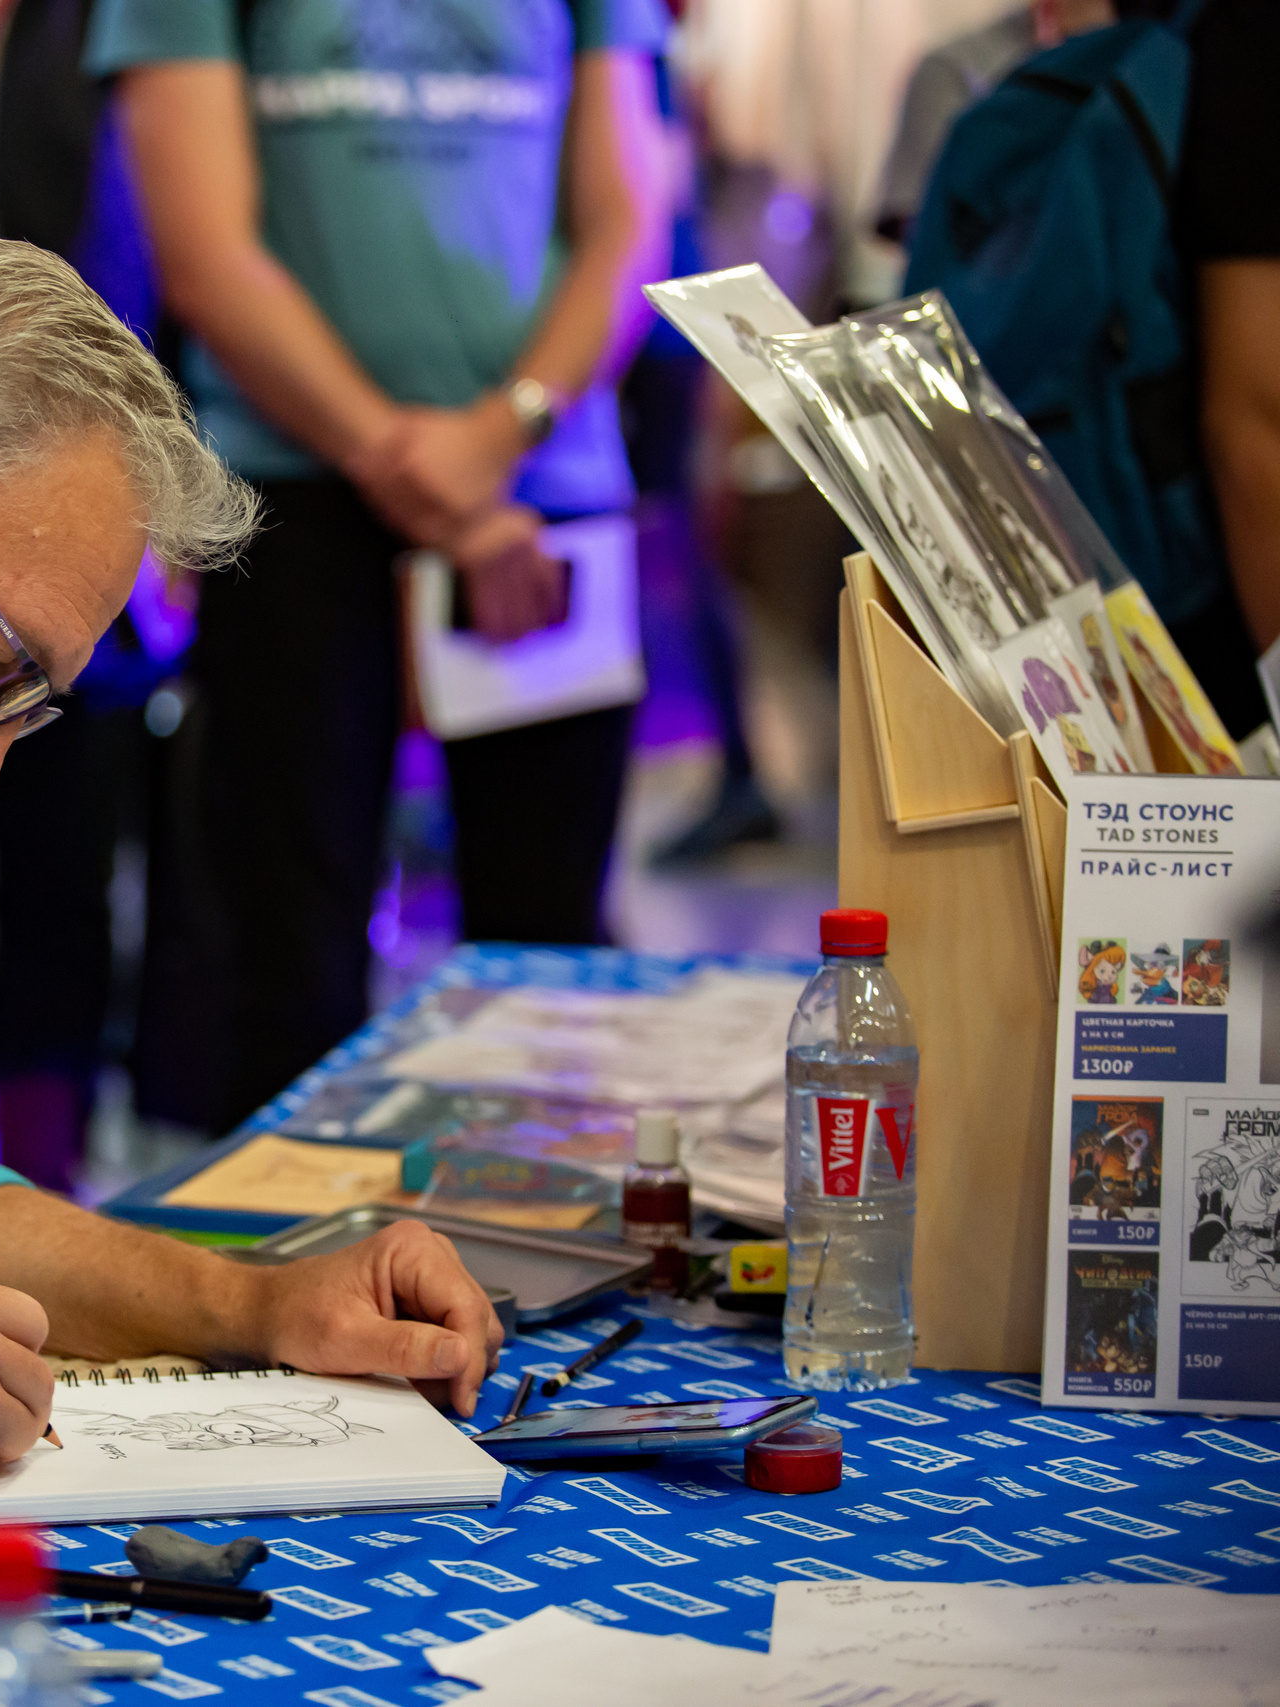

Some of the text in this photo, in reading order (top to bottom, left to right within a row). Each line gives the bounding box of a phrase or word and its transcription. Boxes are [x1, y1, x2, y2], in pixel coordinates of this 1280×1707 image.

[1082, 802, 1234, 823] ТЭД СТОУНС
[1097, 827, 1219, 843] TAD STONES
[1081, 858, 1233, 877] ПРАЙС-ЛИСТ
[1082, 1018, 1175, 1028] ЦВЕТНАЯ КАРТОЧКА
[828, 1107, 855, 1171] Vittel
[574, 1479, 659, 1514] BUBBLE
[854, 1503, 910, 1521] ТВОИ
[1083, 1509, 1170, 1538] BUBBLE
[705, 1528, 761, 1545] ТВОИ
[756, 1512, 843, 1540] BUBBLE
[271, 1540, 343, 1569] BUBBLE
[601, 1530, 687, 1564] BUBBLE
